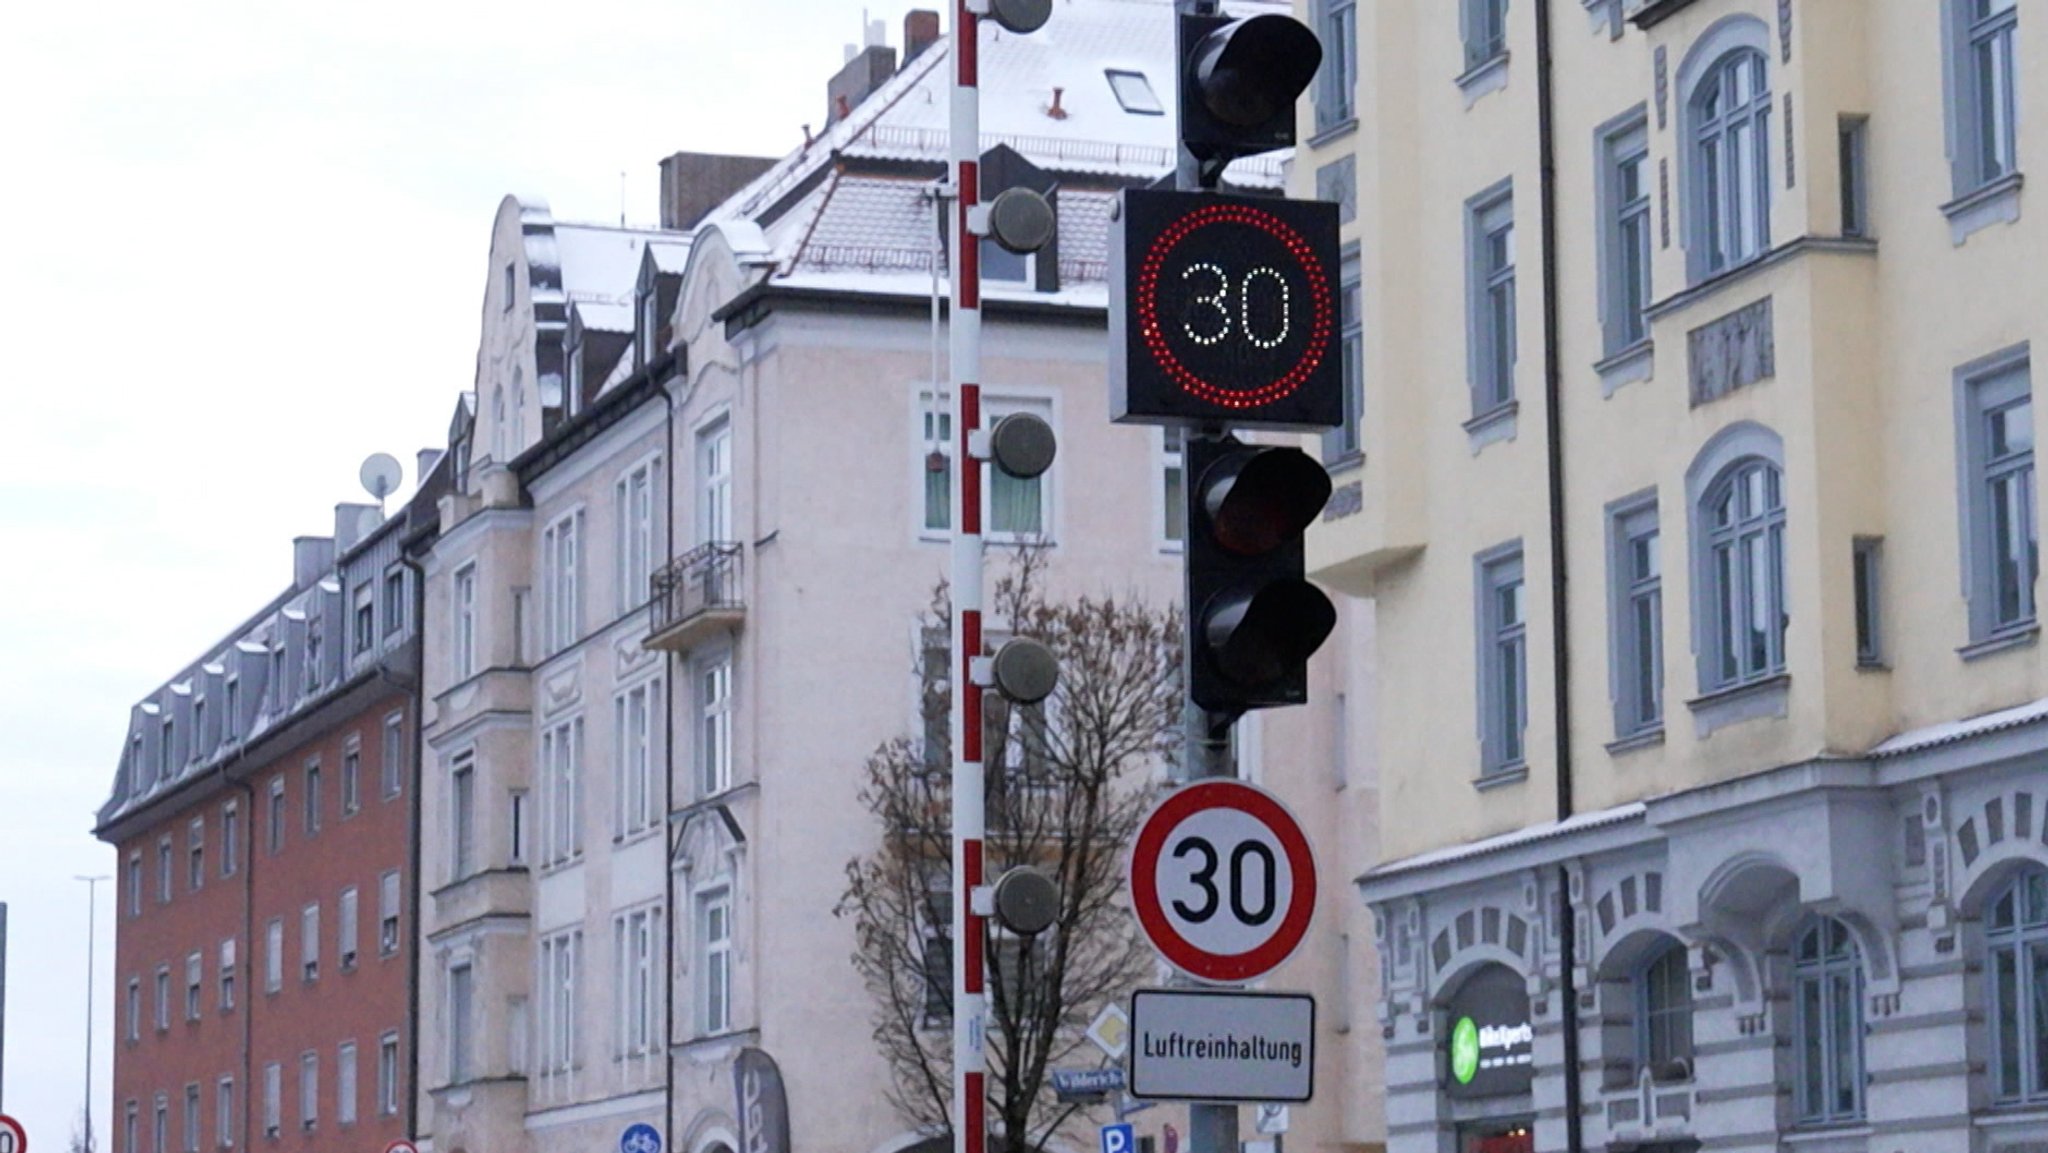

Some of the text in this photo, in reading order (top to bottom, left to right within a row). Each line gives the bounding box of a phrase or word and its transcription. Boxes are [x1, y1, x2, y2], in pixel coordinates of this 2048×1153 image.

[1181, 262, 1290, 349] 30
[1171, 836, 1276, 926] 30
[1144, 1031, 1302, 1068] Luftreinhaltung
[1105, 1129, 1125, 1153] P
